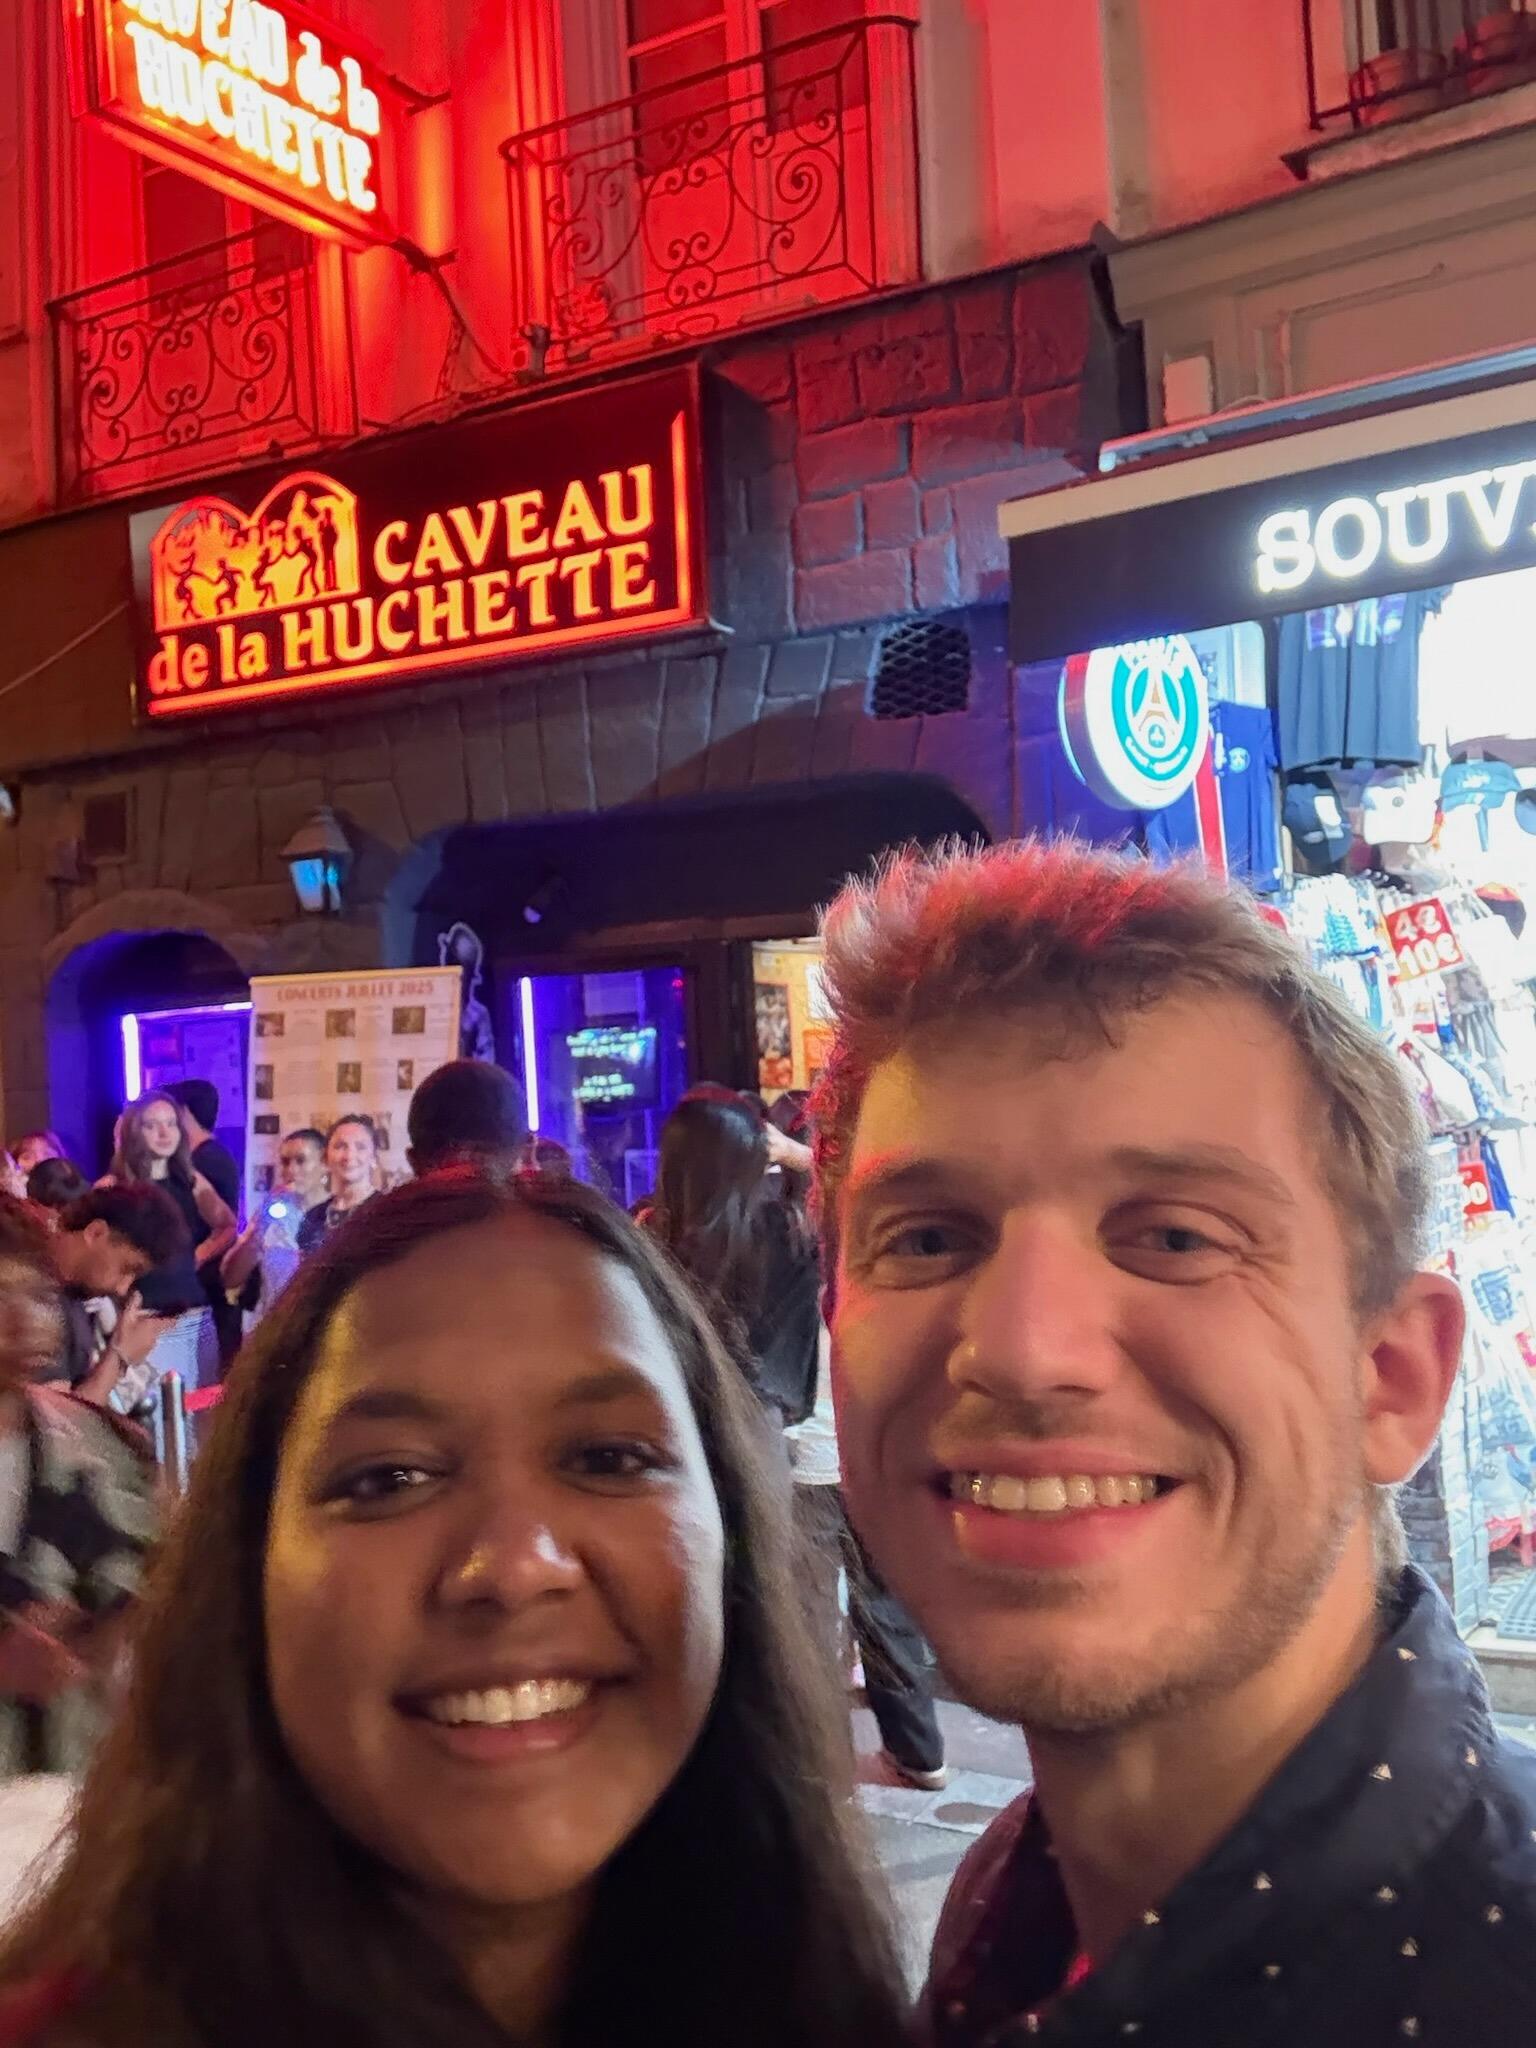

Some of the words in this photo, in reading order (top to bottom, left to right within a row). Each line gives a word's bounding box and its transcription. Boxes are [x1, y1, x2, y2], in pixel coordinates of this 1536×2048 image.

[125, 21, 376, 212] HUCHETTE
[296, 31, 340, 115] de
[373, 464, 654, 584] CAVEAU
[1257, 460, 1536, 593] SOUV
[148, 635, 209, 694] de
[218, 624, 268, 682] la
[280, 542, 657, 671] HUCHETTE
